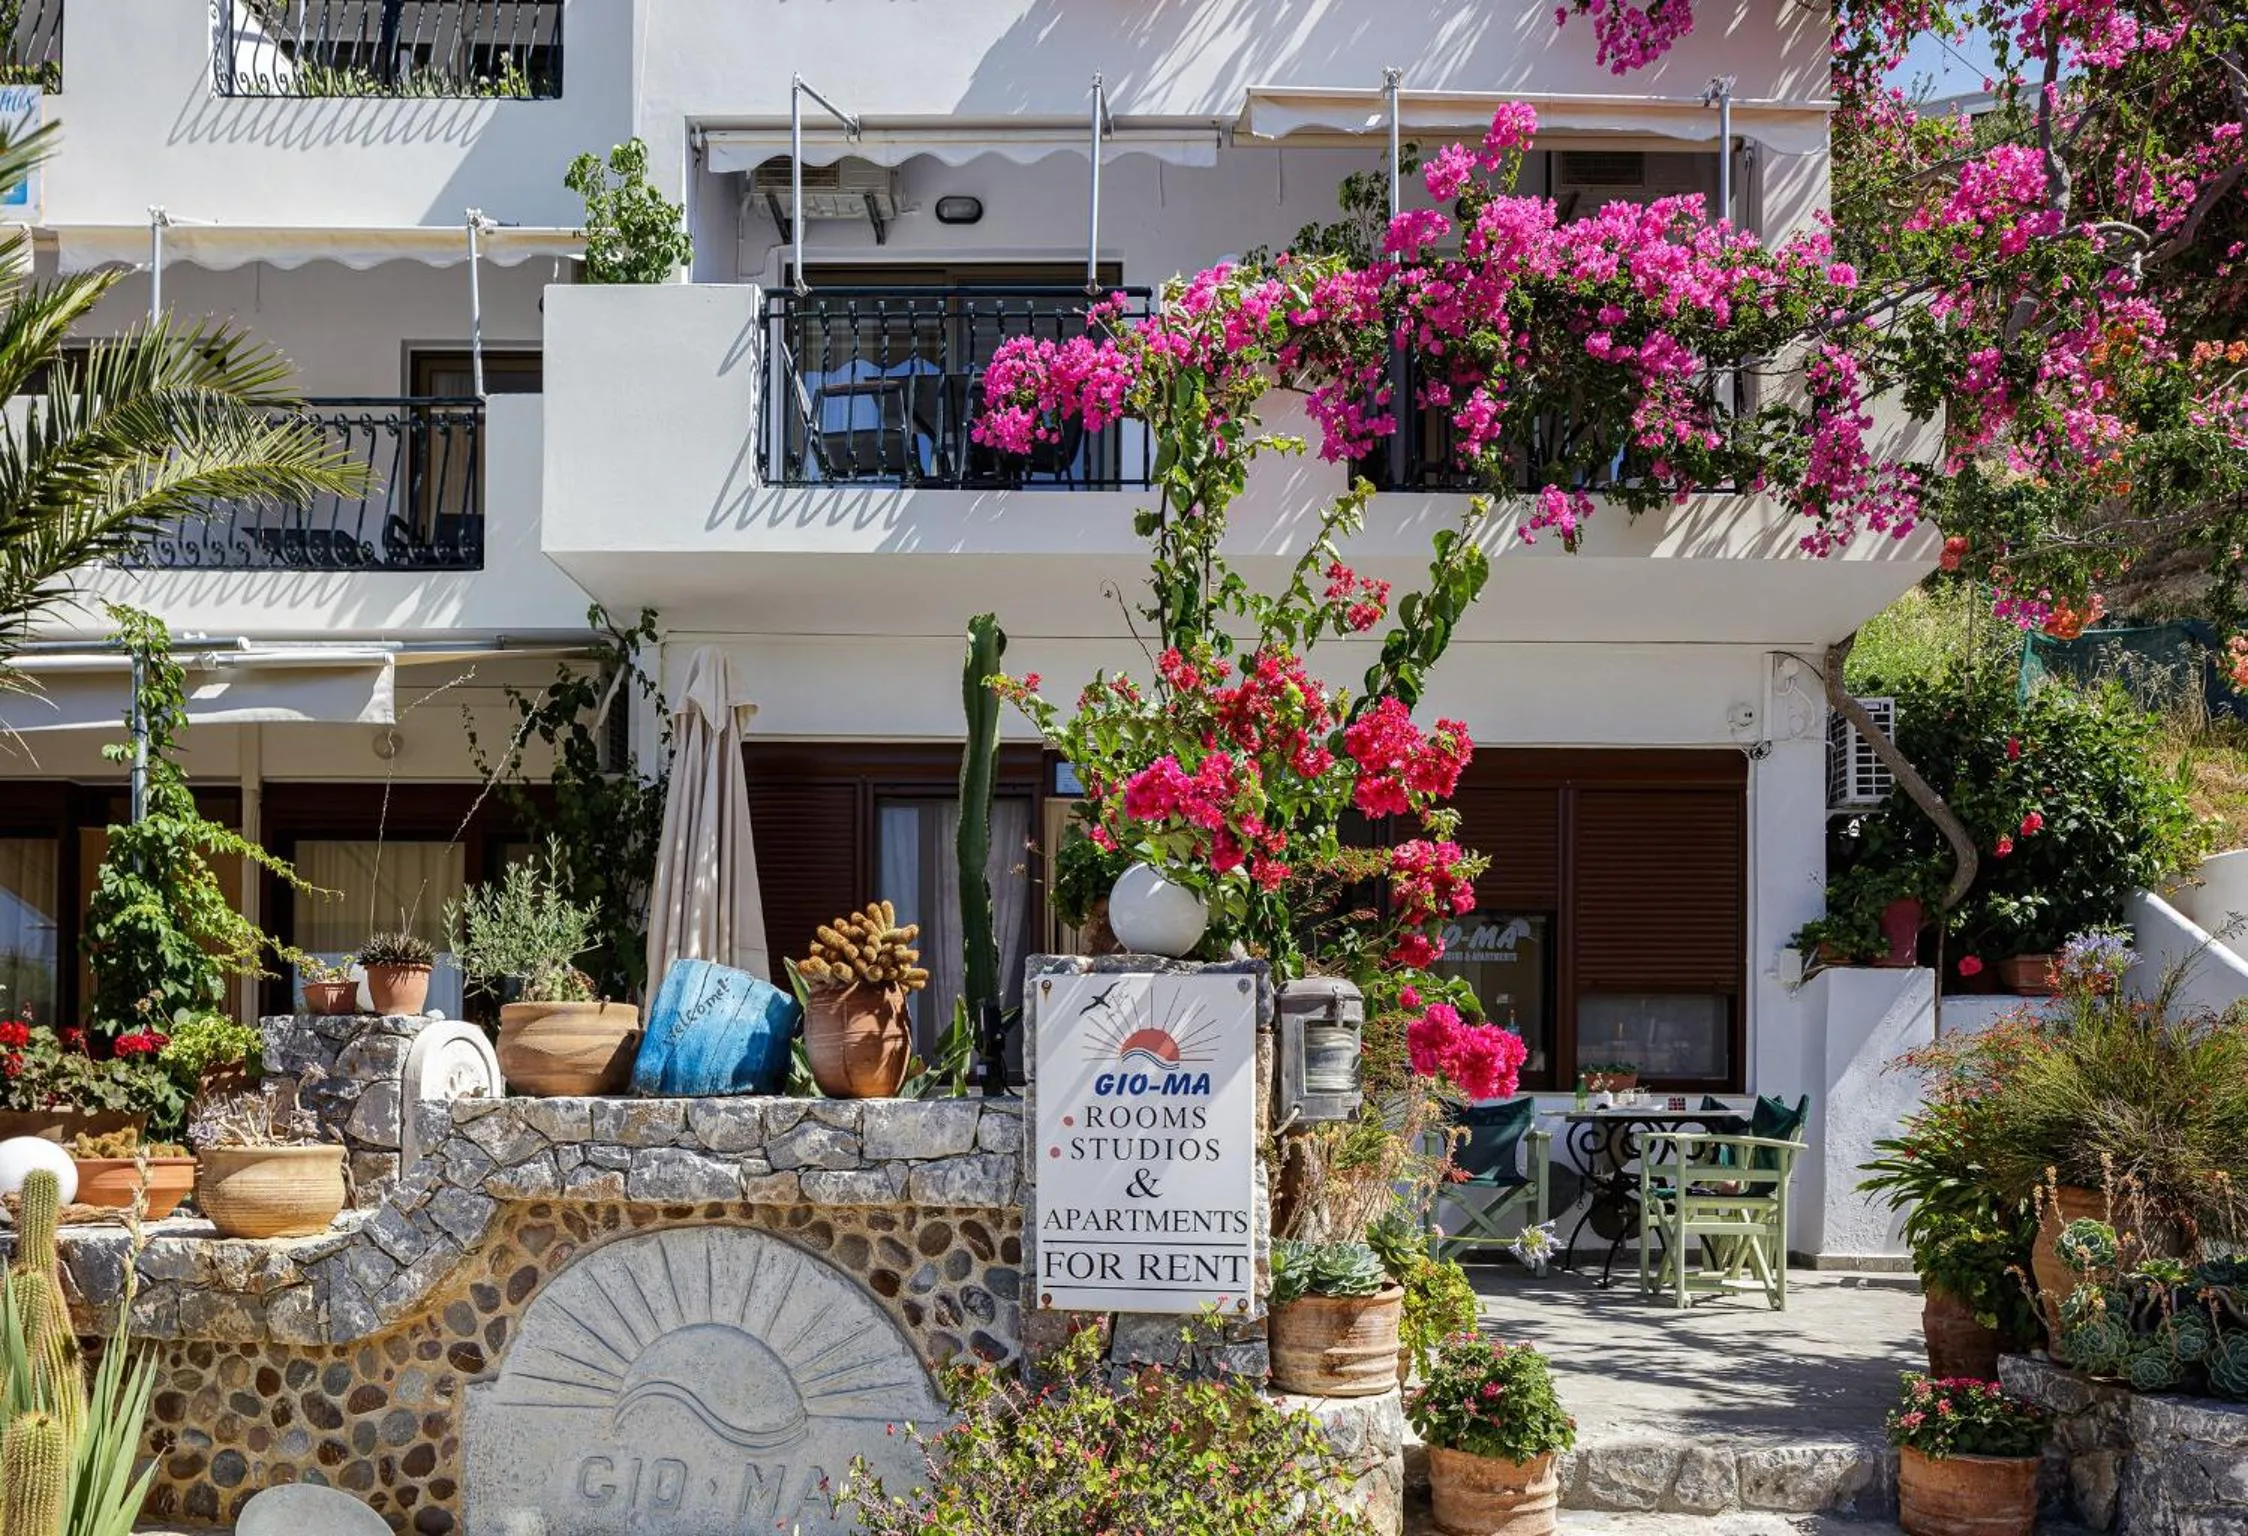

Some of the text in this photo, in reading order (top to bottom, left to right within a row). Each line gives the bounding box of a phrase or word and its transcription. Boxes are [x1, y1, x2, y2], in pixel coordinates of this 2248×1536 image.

[1094, 1072, 1211, 1096] GIO-MA
[1085, 1105, 1207, 1129] ROOMS
[1070, 1136, 1220, 1162] STUDIOS
[1125, 1167, 1164, 1198] &
[1043, 1208, 1248, 1234] APARTMENTS
[1044, 1250, 1249, 1283] FOR RENT
